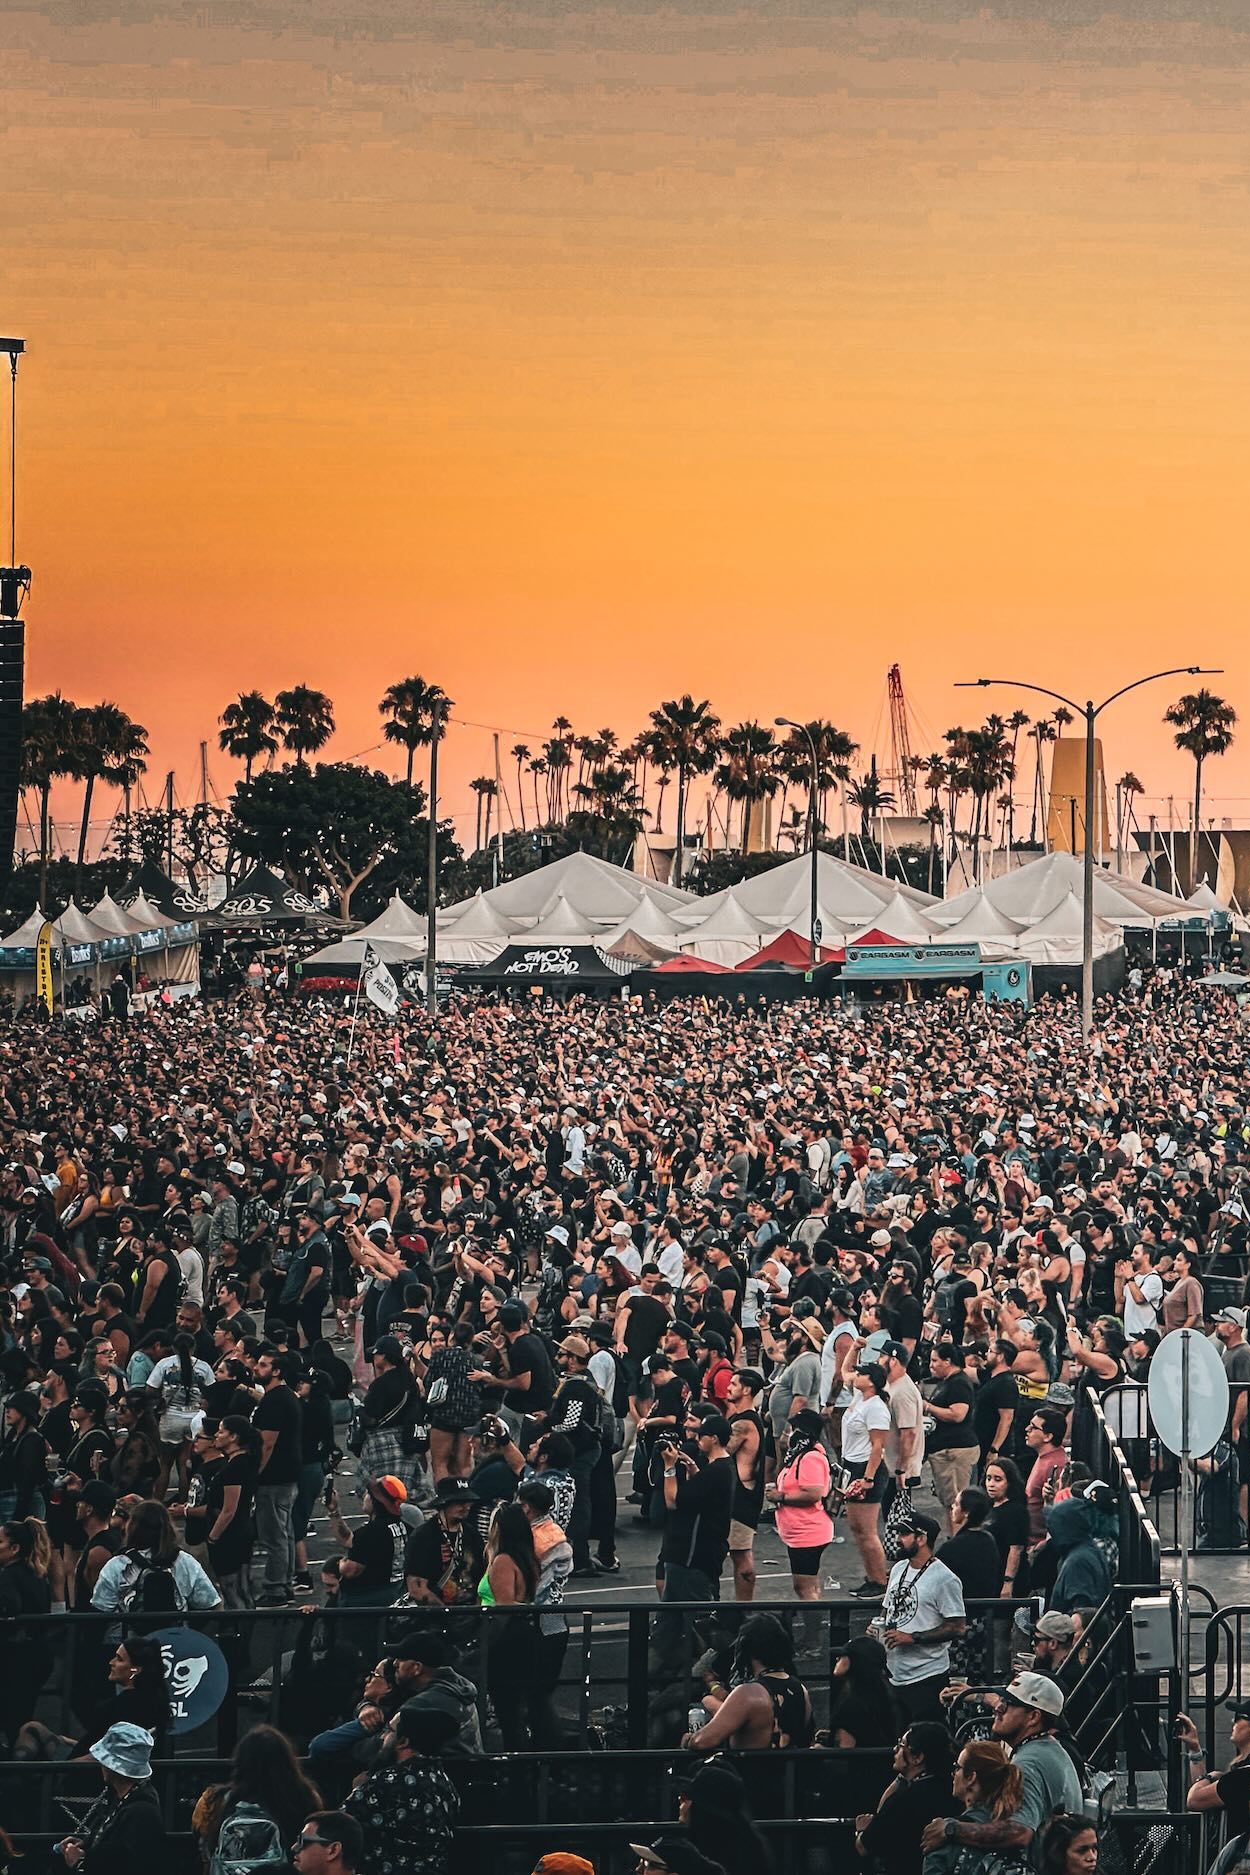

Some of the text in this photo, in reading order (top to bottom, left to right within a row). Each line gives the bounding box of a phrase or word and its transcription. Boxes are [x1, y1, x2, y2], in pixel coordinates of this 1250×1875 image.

[221, 897, 273, 914] 805
[504, 961, 539, 974] NOT
[168, 1701, 189, 1717] SL
